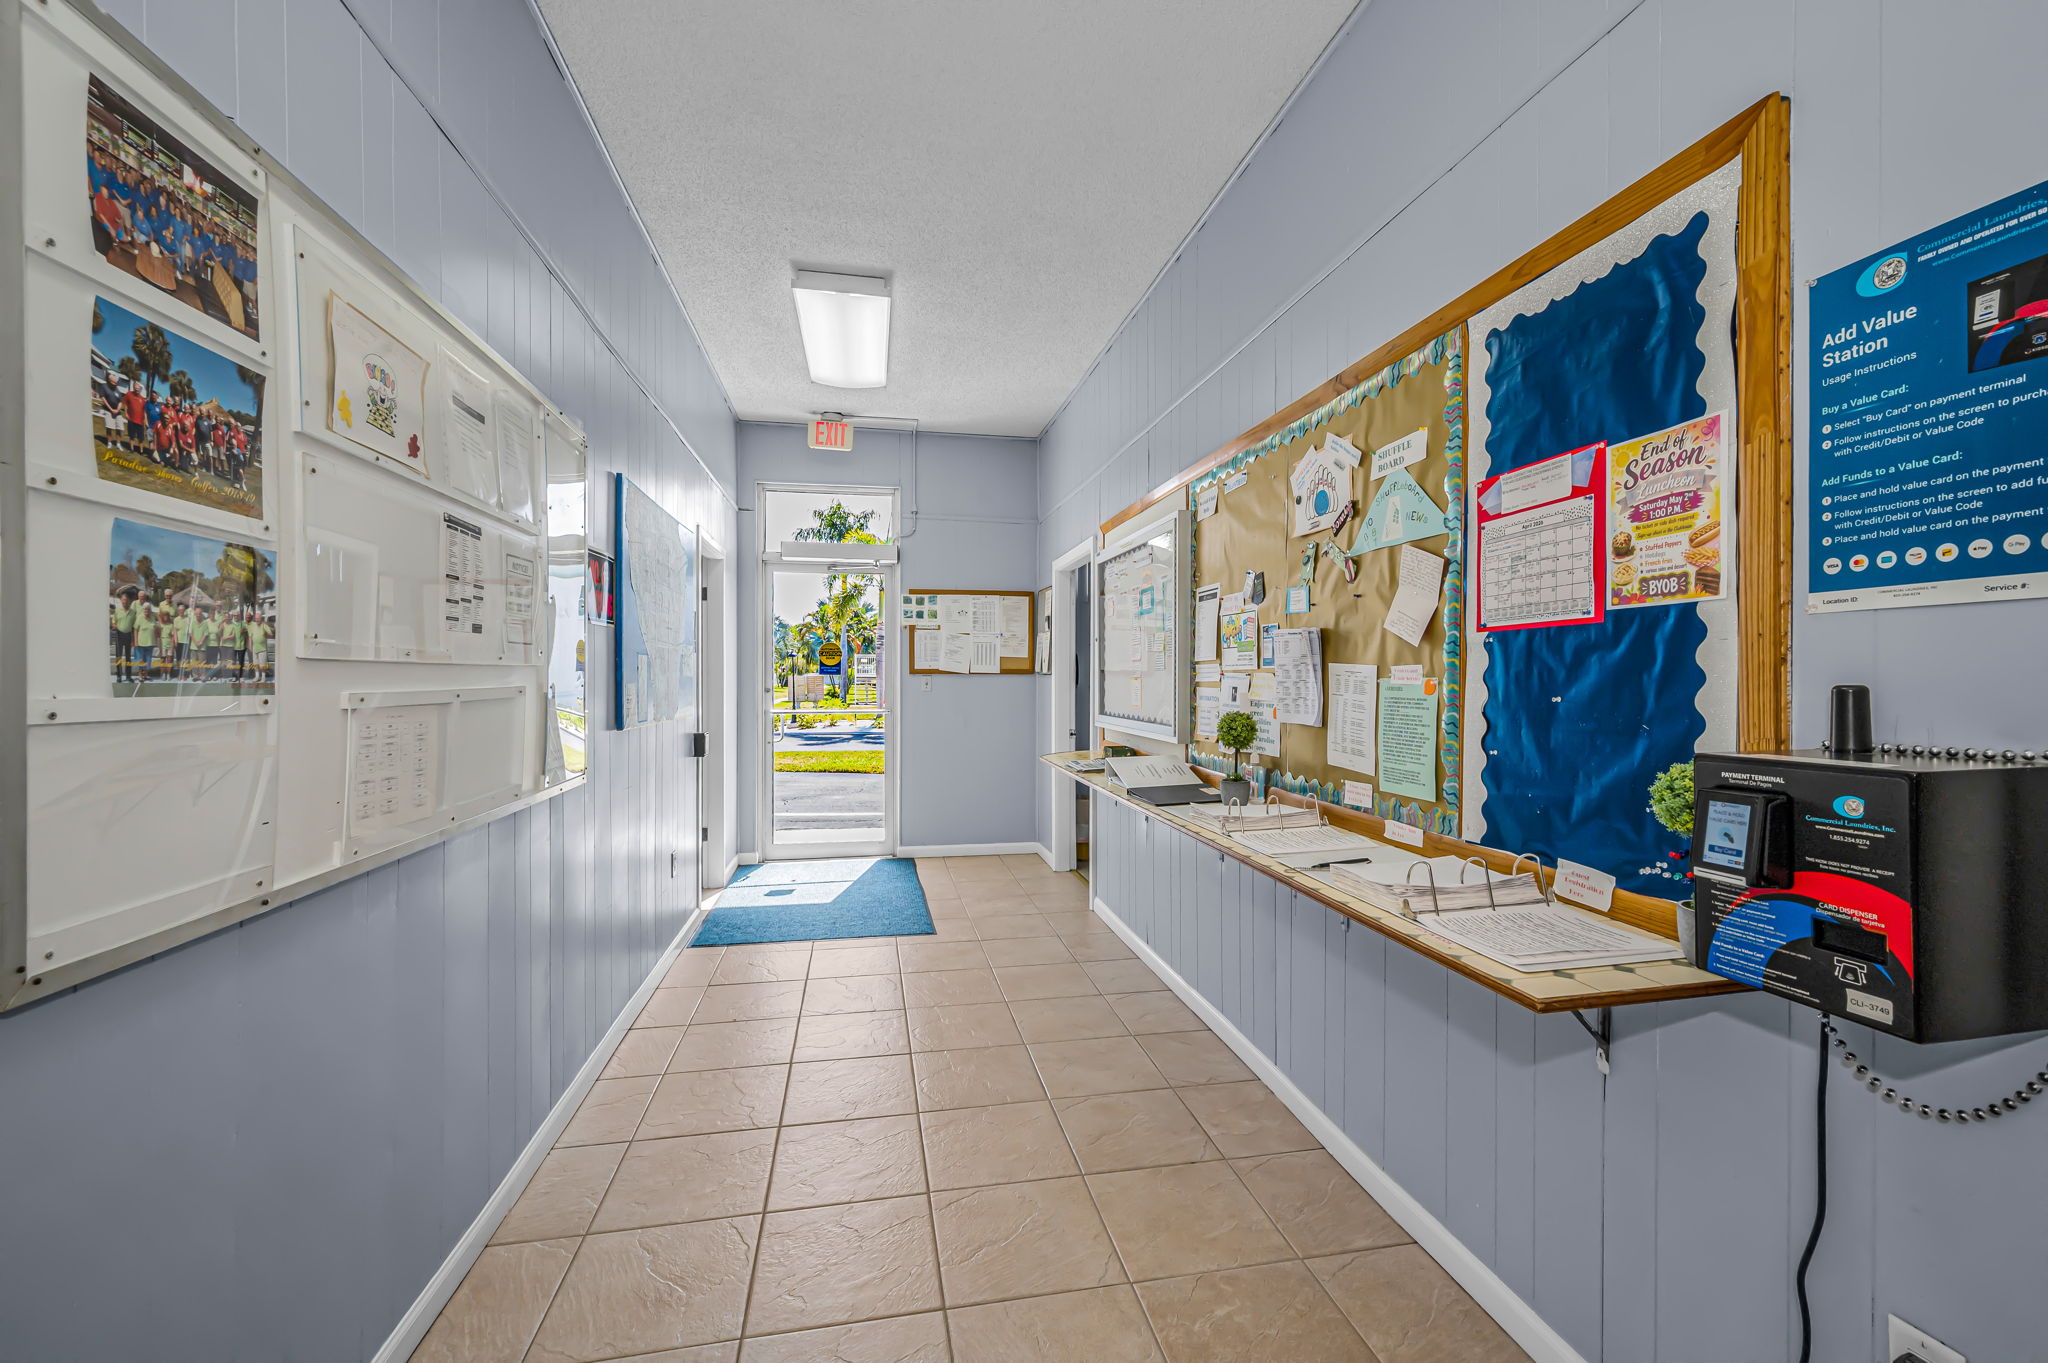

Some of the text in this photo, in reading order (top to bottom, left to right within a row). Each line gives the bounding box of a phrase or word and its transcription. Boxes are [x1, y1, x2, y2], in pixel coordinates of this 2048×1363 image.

[1960, 236, 1973, 246] AND
[1974, 224, 2004, 240] OPERATED
[2005, 218, 2018, 228] FOR
[2019, 211, 2036, 222] OVER
[1822, 306, 1918, 349] Add Value
[1822, 336, 1888, 368] Station
[1822, 351, 1917, 387] Usage Instructions
[1821, 384, 1909, 416] Buy a Value Card:
[1834, 374, 2026, 431] Select "Buy Card" on payment terminal
[1834, 388, 2048, 447] Follow instructions on the screen to purch
[815, 421, 848, 447] EXIT
[1641, 428, 1688, 461] End of
[1834, 416, 1984, 457] with Credit/Debit or Value Code
[103, 450, 149, 472] Paradise
[1377, 440, 1412, 461] SHUFFLE
[1378, 455, 1405, 473] BOARD
[1623, 445, 1707, 491] Season
[1821, 450, 1963, 487] Add Funds to a Value Card:
[1834, 457, 2044, 504] Place and hold value card on the payment
[1636, 473, 1696, 500] Luncheon
[1834, 507, 1862, 519] Follow
[1864, 498, 1920, 515] instructions
[1922, 494, 1935, 504] on
[1937, 490, 1954, 501] the
[1957, 484, 1993, 498] screen
[1996, 481, 2007, 491] to
[2011, 477, 2033, 490] add
[1639, 496, 1668, 513] Saturday
[1669, 494, 1683, 508] May
[1649, 506, 1683, 520] 1:00 P.M.
[1834, 500, 1983, 529] with Credit/Debit or Value Code
[1834, 507, 2044, 544] Place and hold value card on the payment
[1645, 541, 1682, 551] Stuffed Peppers
[1648, 577, 1679, 595] BYOB
[1984, 583, 2018, 593] Service
[1822, 597, 1849, 605] Location
[1721, 771, 1784, 784] PAYMENT TERMINAL
[1805, 814, 1843, 825] Commercial
[1815, 907, 1851, 920] Dispensador
[1818, 902, 1878, 920] CARD DISPENSER
[1850, 999, 1890, 1016] CLI-3749
